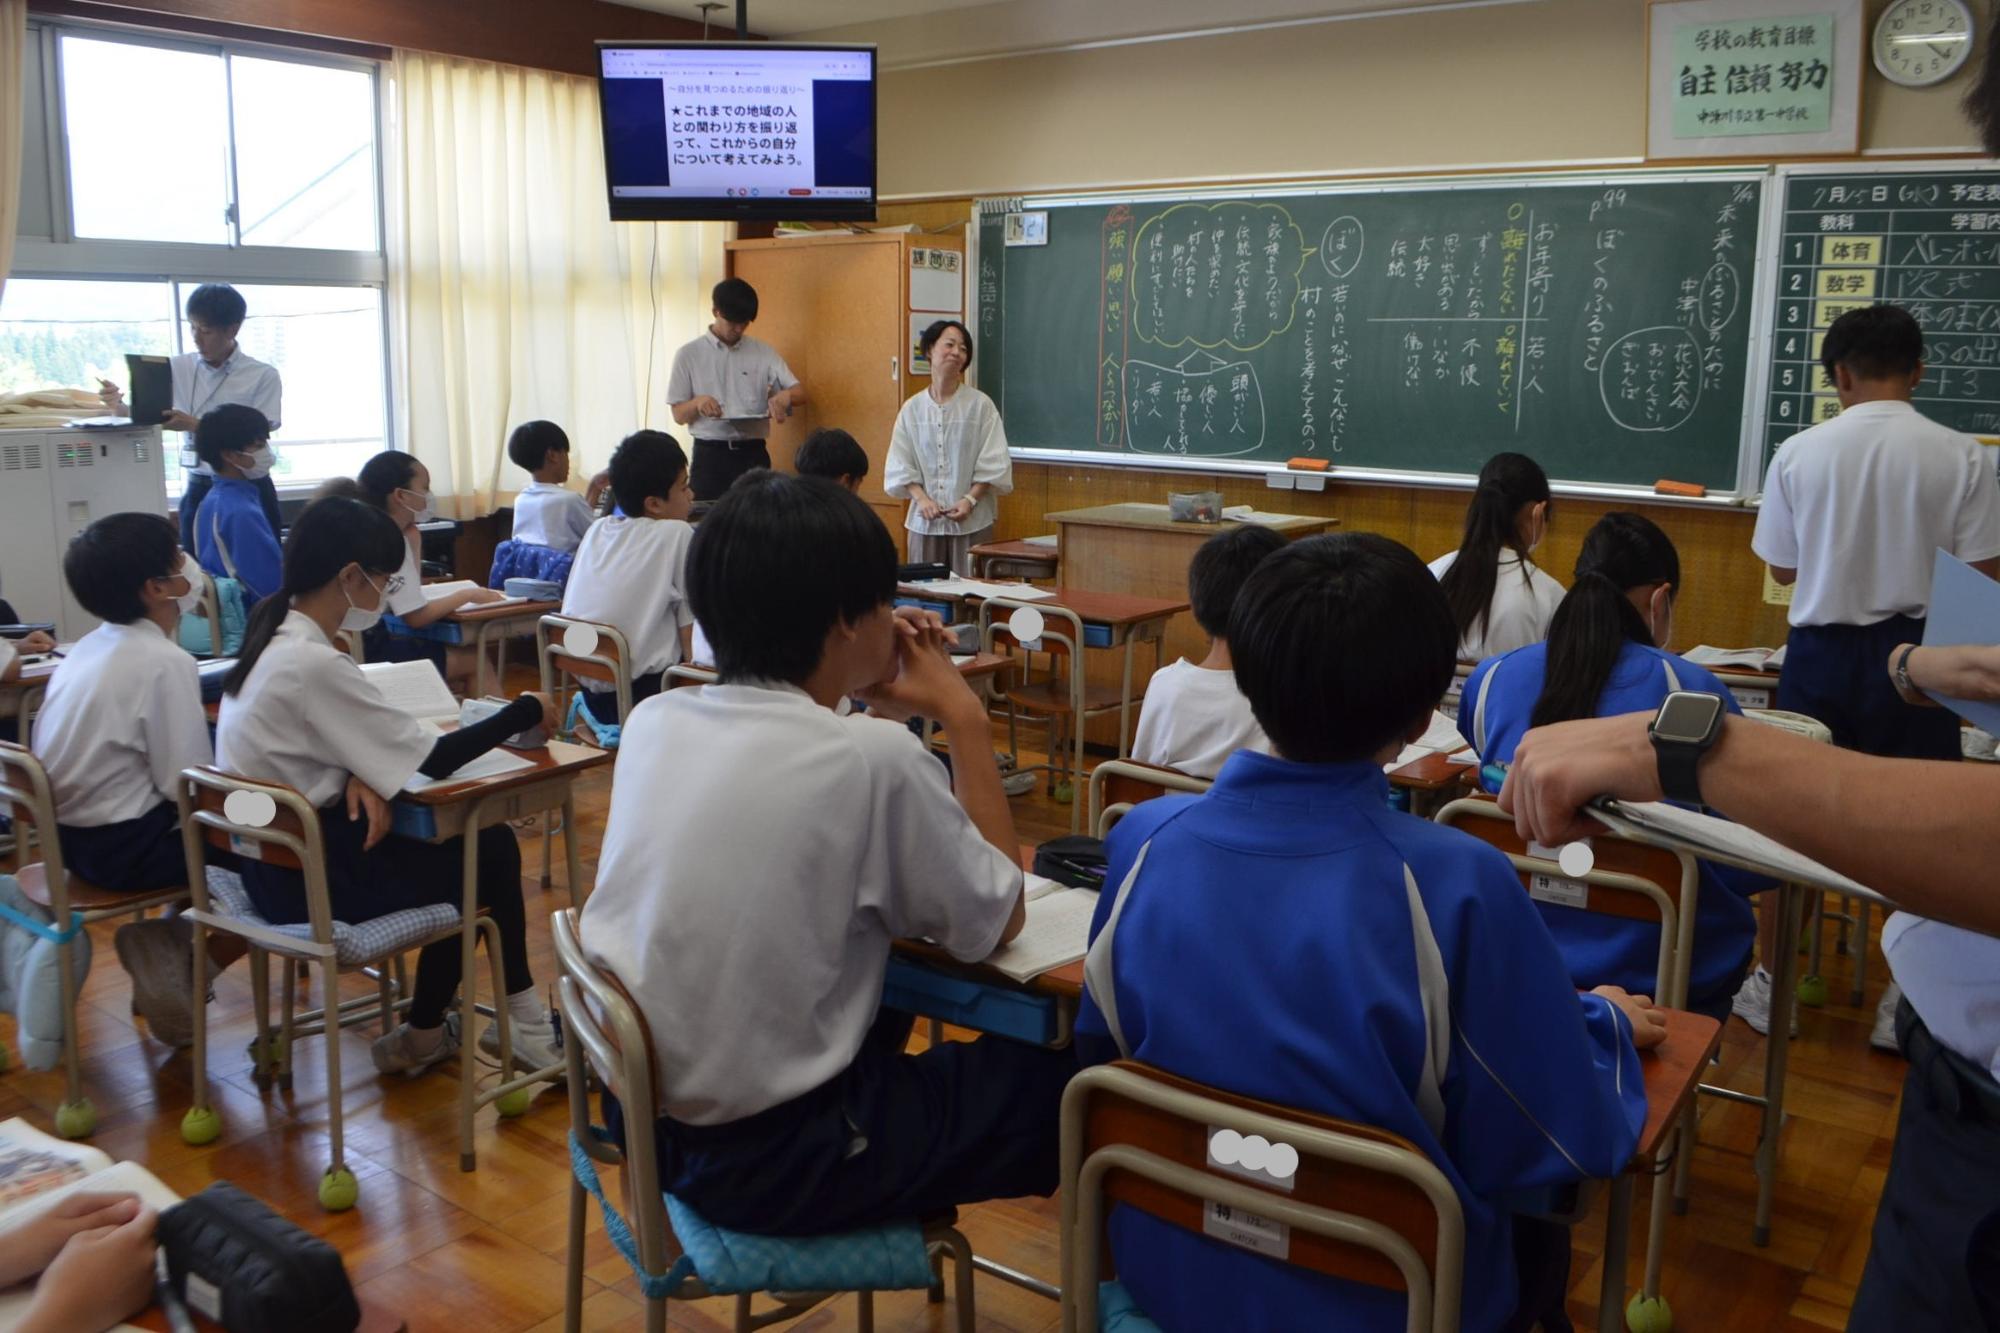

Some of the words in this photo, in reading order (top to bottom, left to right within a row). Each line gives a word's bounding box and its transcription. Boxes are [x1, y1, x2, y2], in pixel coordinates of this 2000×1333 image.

[1947, 16, 1956, 29] 2
[1695, 25, 1816, 51] 学校の教育目標
[1901, 58, 1910, 70] 7
[1914, 63, 1923, 75] 6
[1931, 58, 1939, 70] 5
[1679, 64, 1717, 97] 自主
[1725, 62, 1771, 96] 信頼
[1777, 58, 1828, 90] 努力
[672, 120, 797, 134] との関わり方を振り返
[673, 137, 796, 150] って、これからの自分
[673, 153, 802, 167] について考えてみよう。
[1819, 214, 1855, 231] 教科
[1329, 227, 1357, 273] ぼく
[1387, 239, 1408, 278] 伝統
[1794, 242, 1802, 259] 1
[1832, 242, 1873, 260] 体育
[1413, 236, 1434, 289] 大好き
[1527, 223, 1560, 317] お年寄り
[1790, 274, 1801, 291] 2
[1826, 275, 1865, 293] 数学
[1584, 229, 1625, 372] ぼくのふるさと
[1787, 306, 1798, 323] 3
[1784, 337, 1796, 354] 4
[1432, 338, 1450, 379] いなか
[1460, 338, 1482, 386] 不便
[1524, 336, 1546, 394] 若い人
[1669, 344, 1693, 410] 花火大会
[1782, 369, 1794, 386] 5
[1779, 400, 1790, 417] 6
